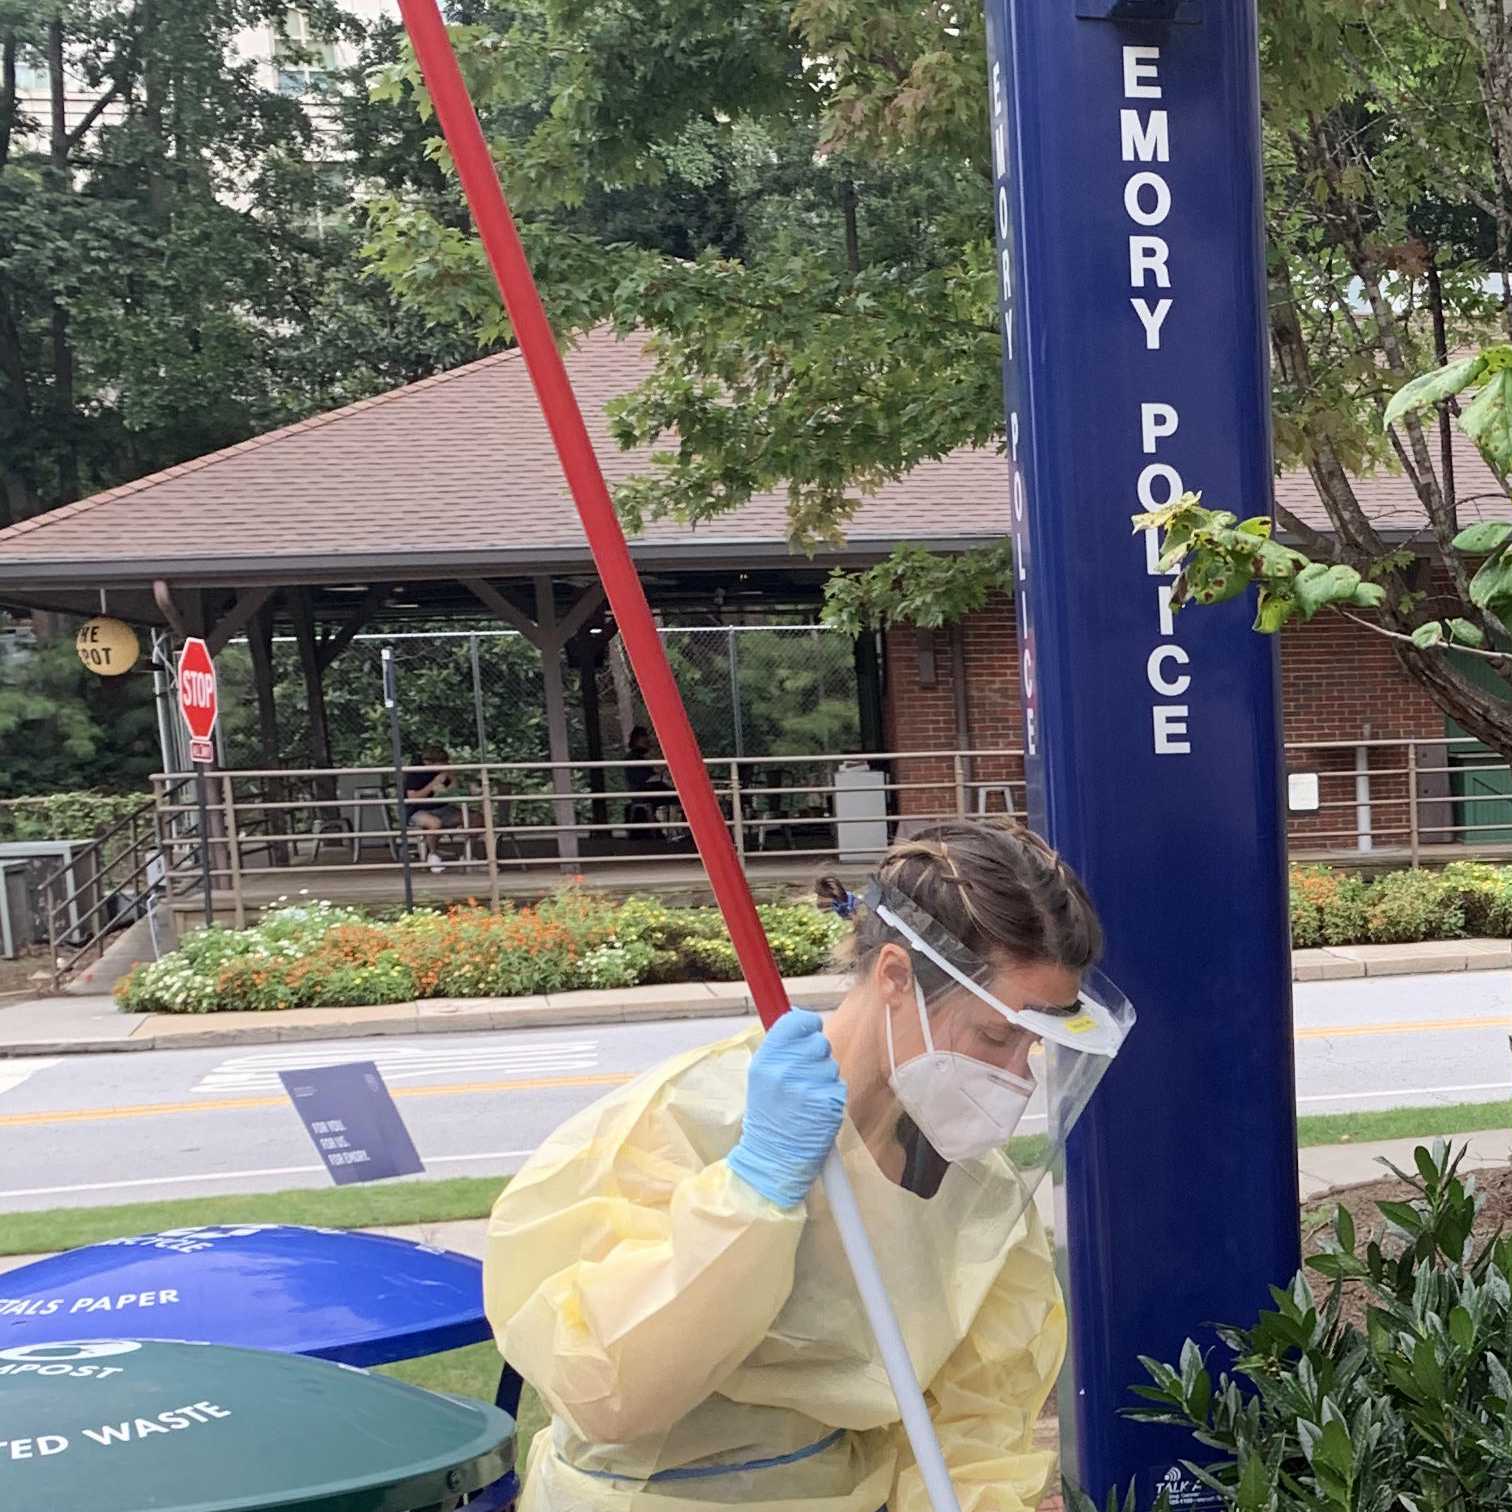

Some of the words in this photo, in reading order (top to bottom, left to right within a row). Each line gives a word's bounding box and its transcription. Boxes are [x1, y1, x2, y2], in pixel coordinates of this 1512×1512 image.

[1119, 45, 1173, 350] EMORY
[992, 61, 1014, 361] EMORY
[1010, 411, 1036, 756] POLICE
[1137, 402, 1192, 755] POLICE
[182, 669, 214, 709] STOP
[70, 1289, 180, 1313] PAPER
[81, 1400, 232, 1446] WASTE
